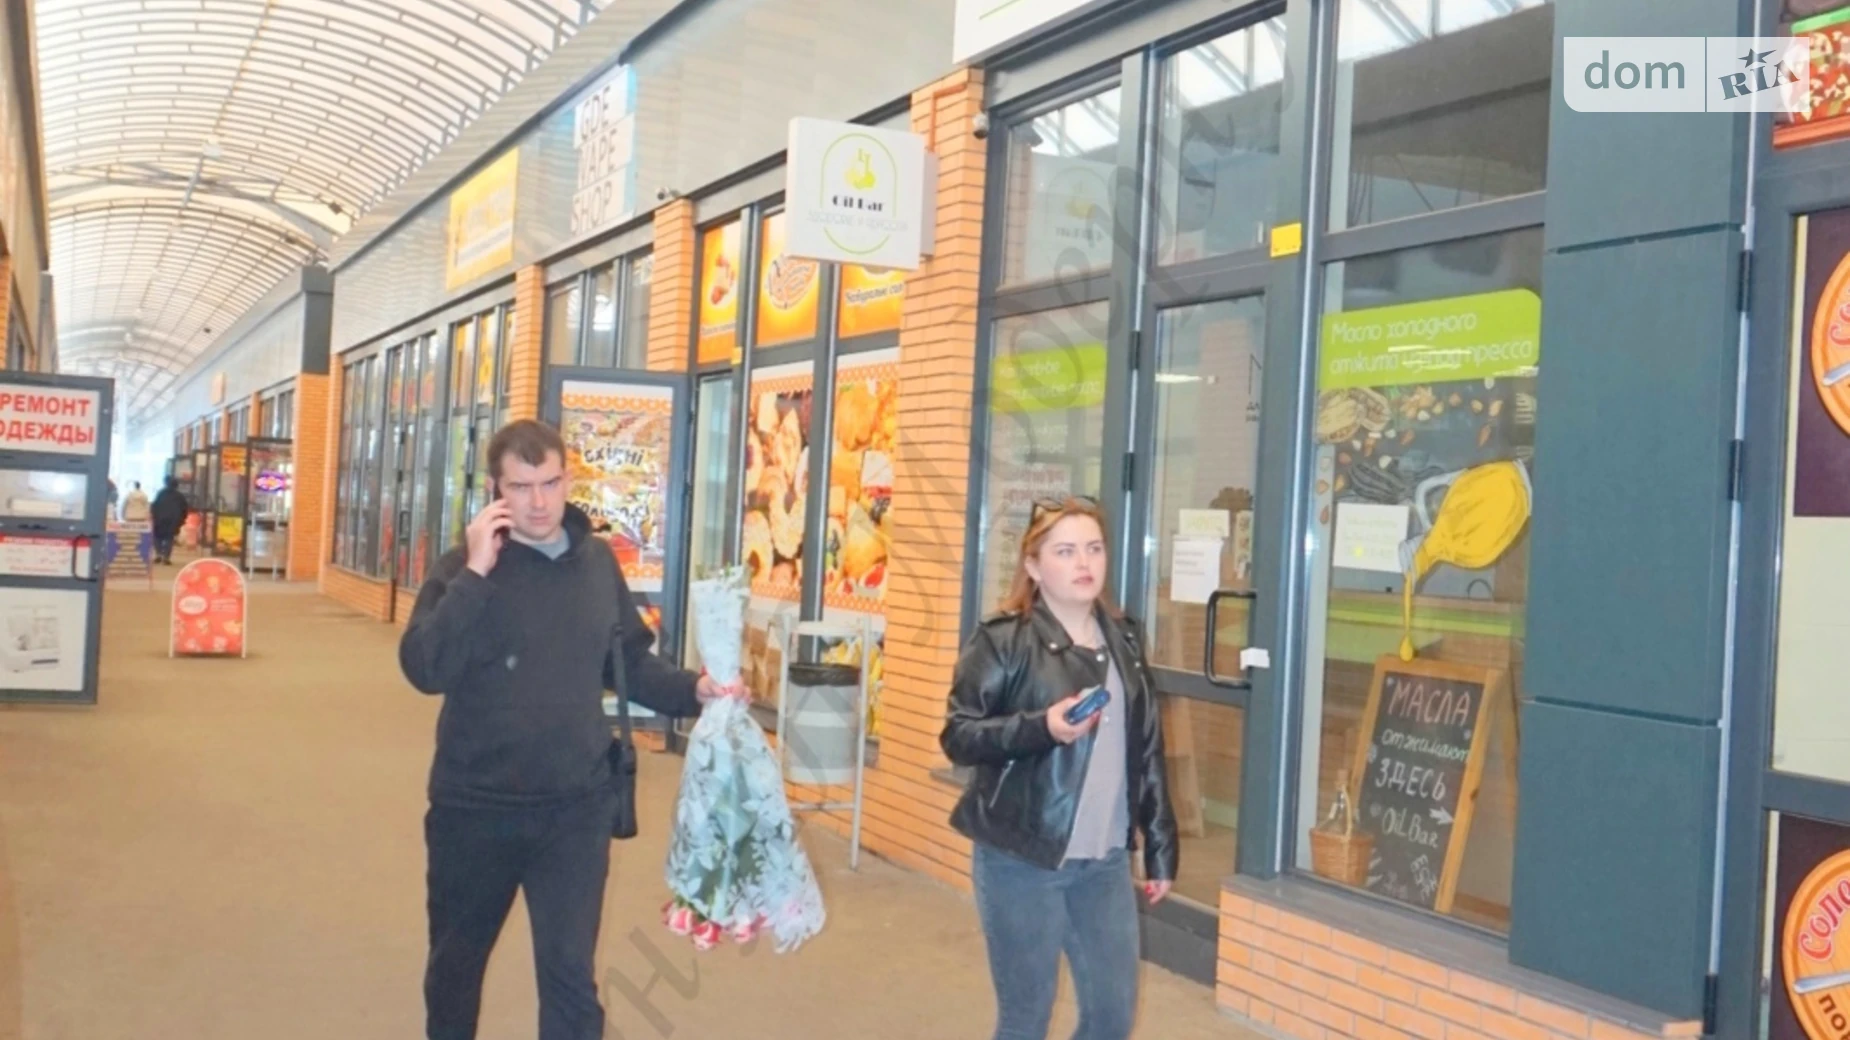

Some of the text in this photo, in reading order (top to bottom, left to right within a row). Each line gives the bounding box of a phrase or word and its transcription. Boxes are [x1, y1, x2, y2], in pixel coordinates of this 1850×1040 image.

[582, 86, 612, 140] GDE
[579, 128, 617, 187] VAPE
[572, 181, 613, 235] SHOP
[1331, 312, 1477, 345] Масло холодного
[1465, 339, 1533, 368] пресса
[0, 393, 91, 417] РЕМОНТ
[1388, 681, 1472, 726] МАСЛА
[1375, 757, 1447, 801] ЗДЕСЬ
